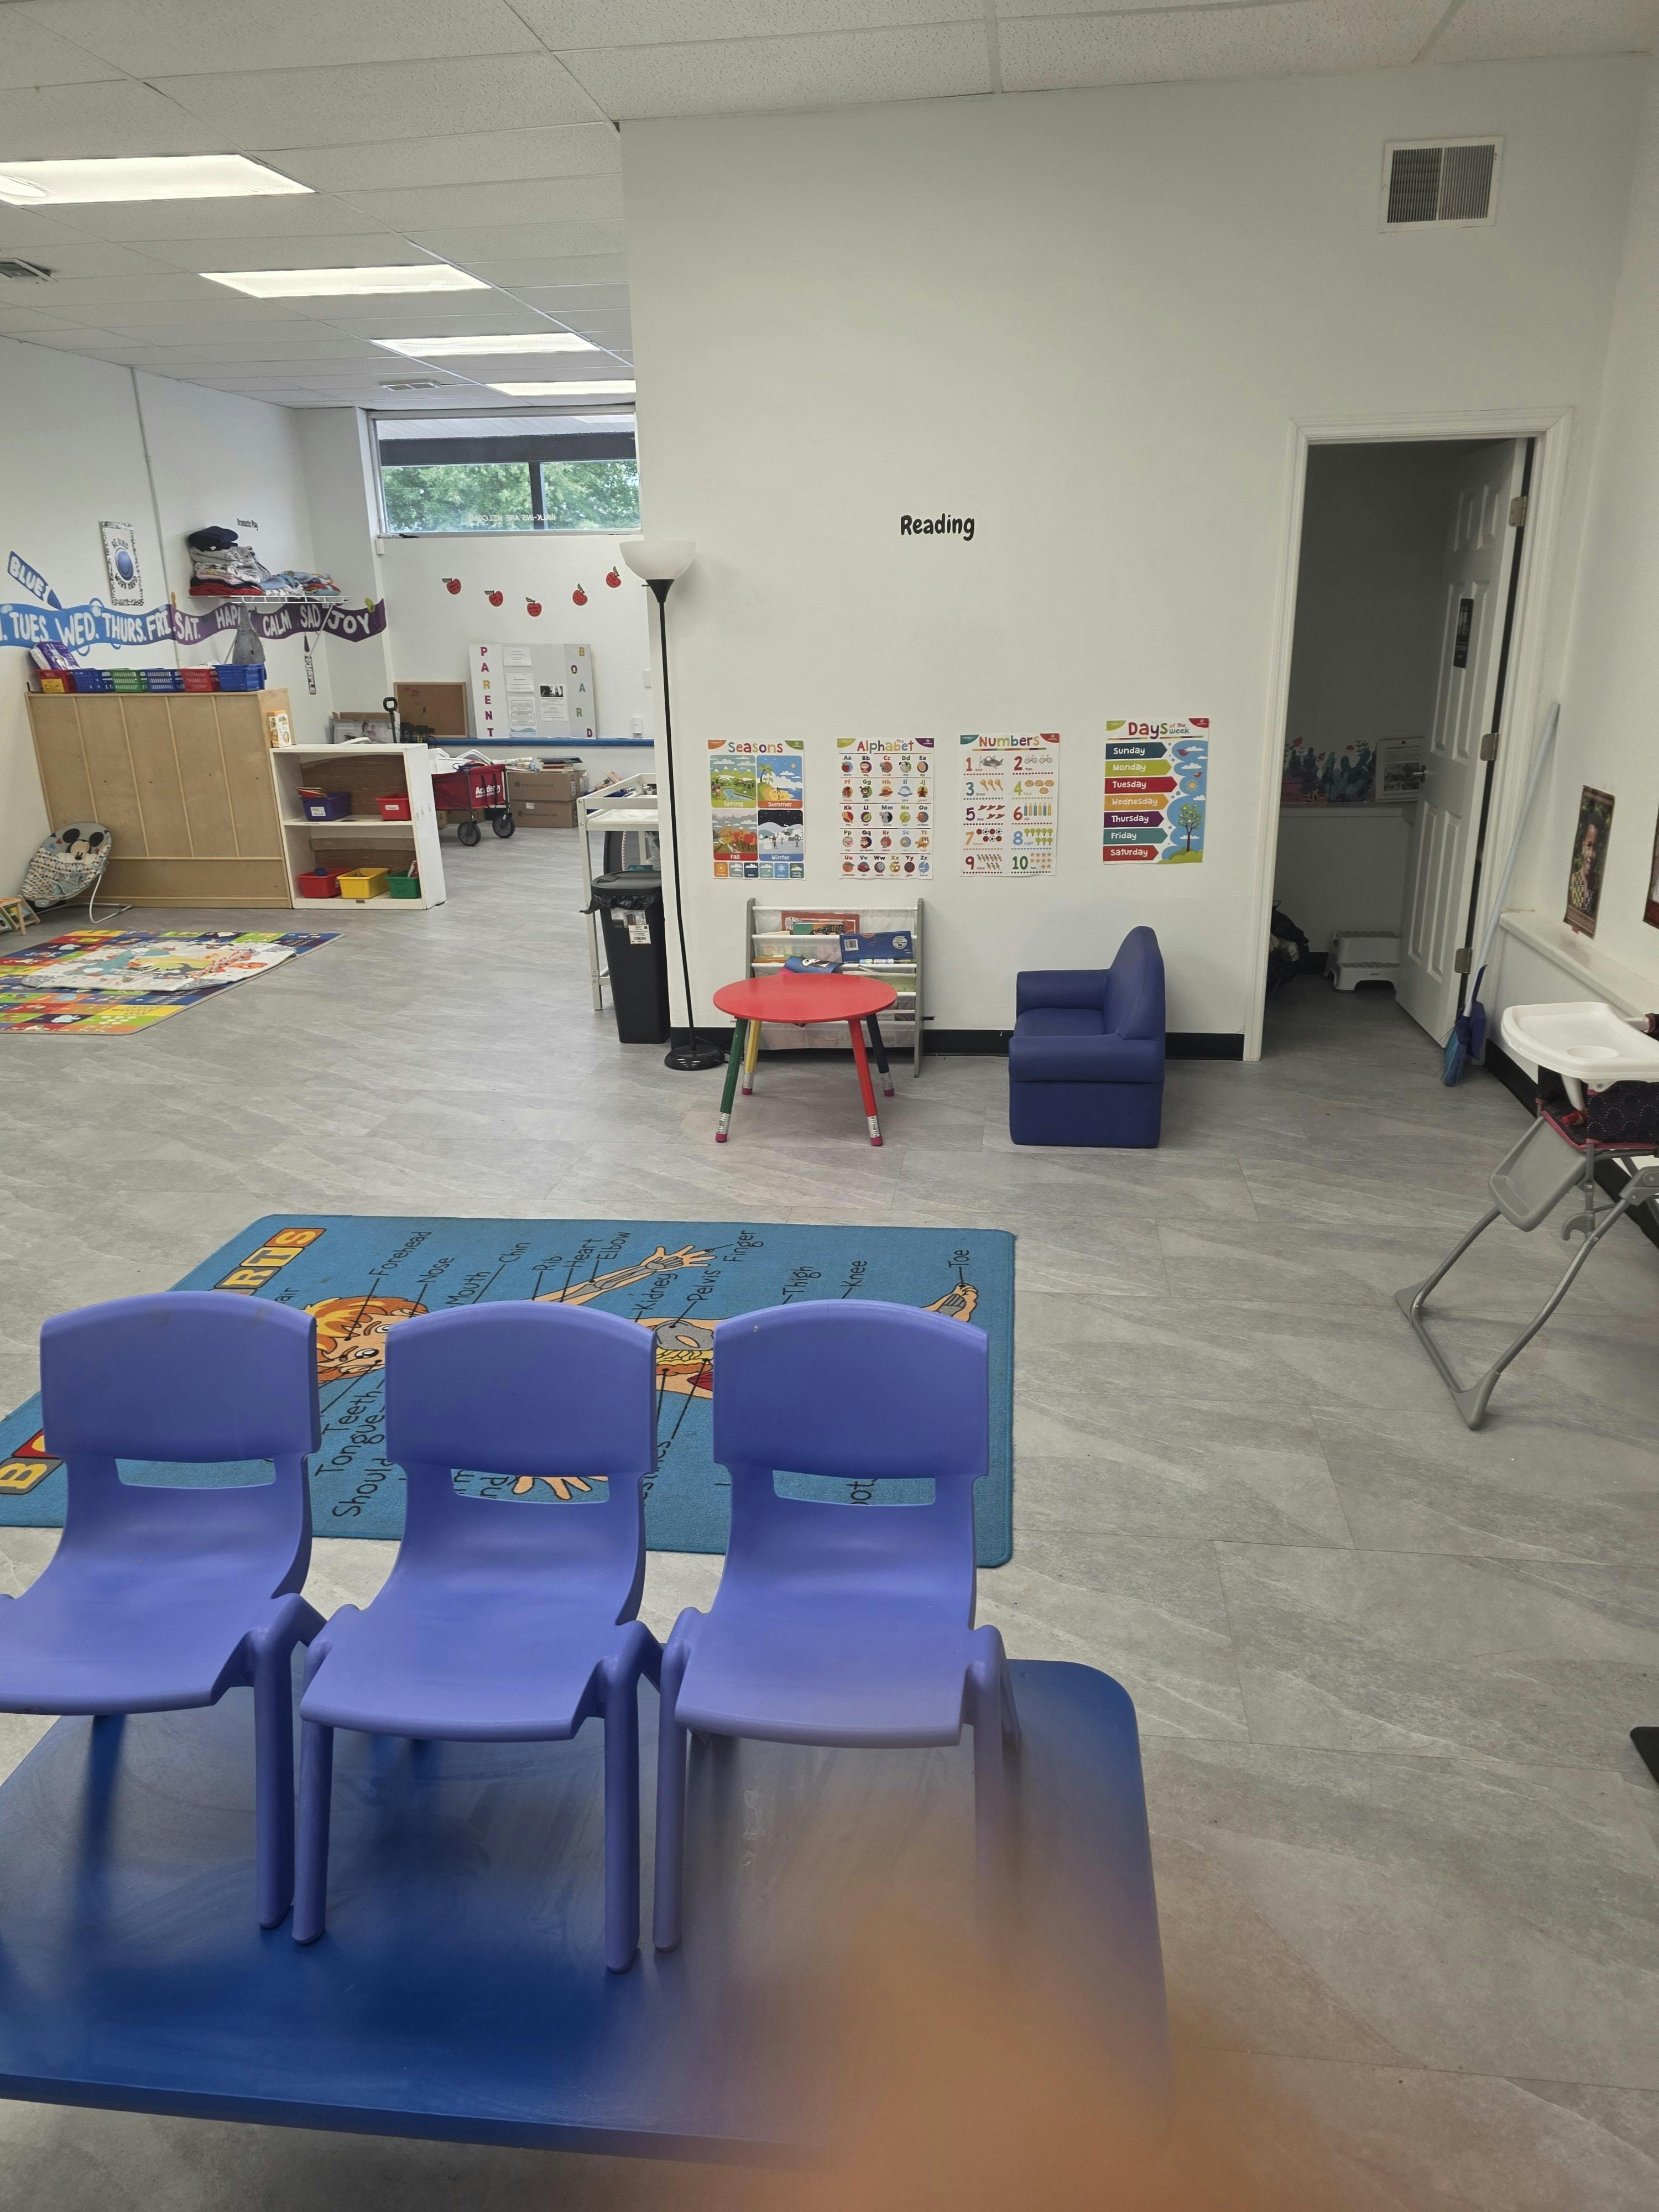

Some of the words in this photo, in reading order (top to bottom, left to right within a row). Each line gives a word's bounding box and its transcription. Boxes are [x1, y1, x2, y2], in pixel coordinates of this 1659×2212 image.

[901, 513, 974, 541] Reading
[9, 555, 46, 597] BLUE
[55, 612, 99, 647] WED.
[102, 612, 147, 643] THURS.
[146, 609, 176, 640] FRI.
[175, 614, 201, 641] SAT.
[263, 609, 292, 637] CALM
[300, 604, 321, 628] SAD
[327, 610, 371, 634] JOY
[480, 646, 494, 737] PARENT
[571, 646, 593, 738] BOARD
[1128, 722, 1168, 739] Days
[728, 742, 783, 753] Seasons
[857, 740, 914, 754] Alphabet
[979, 735, 1040, 747] Numbers
[1113, 747, 1145, 755] Sunday
[966, 757, 972, 771] 1
[1014, 756, 1022, 770] 2
[966, 782, 974, 796] 3
[1014, 781, 1023, 795] 4
[1112, 781, 1146, 789] Tuesday
[966, 807, 975, 821] 5
[1013, 806, 1022, 820] 6
[1112, 815, 1149, 823] Thursday
[966, 831, 974, 845] 7
[1013, 831, 1023, 845] 8
[1110, 848, 1148, 857] Saturday
[966, 856, 974, 869] 9
[1013, 856, 1028, 869] 10
[369, 1231, 432, 1275] Forehead
[499, 1242, 531, 1263] Chin
[562, 1238, 603, 1267] Heart
[597, 1232, 631, 1260] Elbow
[723, 1230, 764, 1262] Finger
[532, 1256, 562, 1271] Rib
[948, 1249, 969, 1267] Toe
[417, 1257, 455, 1283] Nose
[840, 1260, 867, 1287] Knee
[445, 1272, 491, 1305] Mouth
[686, 1270, 721, 1301] Pelvis
[782, 1266, 821, 1295] Thigh
[274, 1286, 300, 1304] air
[632, 1274, 678, 1310] Kidney
[321, 1391, 383, 1435] Teeth
[314, 1415, 385, 1477] Tongue
[332, 1458, 394, 1517] Should
